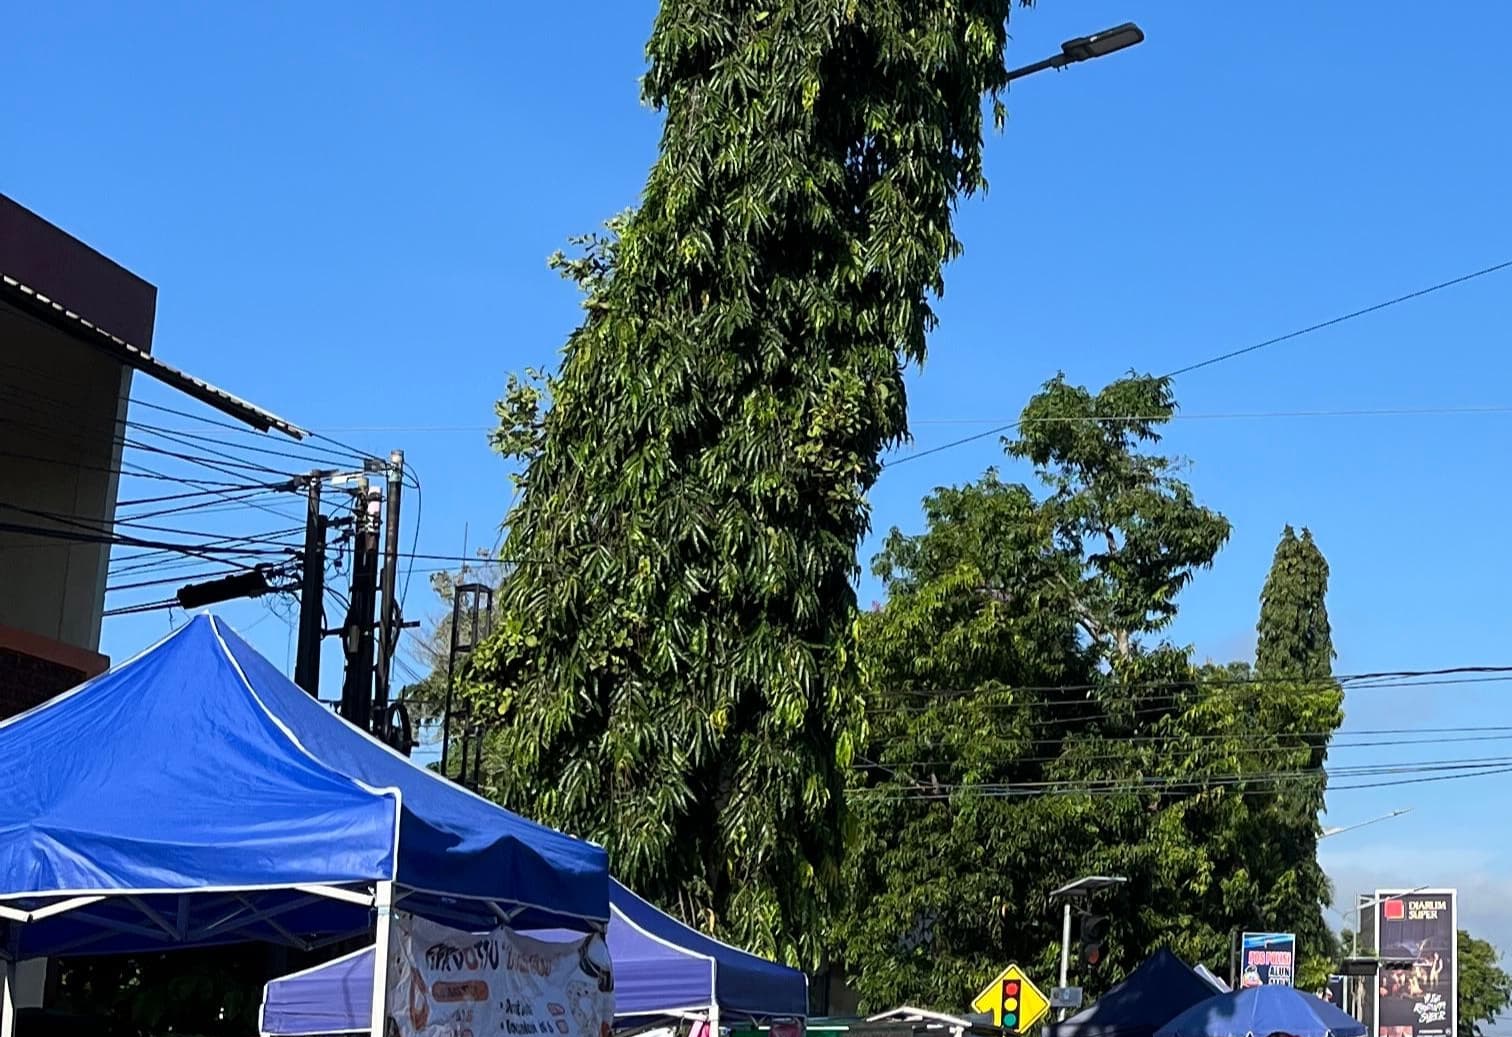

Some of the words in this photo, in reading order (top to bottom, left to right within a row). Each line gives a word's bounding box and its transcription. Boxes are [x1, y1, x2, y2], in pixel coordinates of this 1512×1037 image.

[1408, 911, 1438, 920] SUPER
[1248, 951, 1265, 965] POS
[1268, 965, 1291, 977] ALUN
